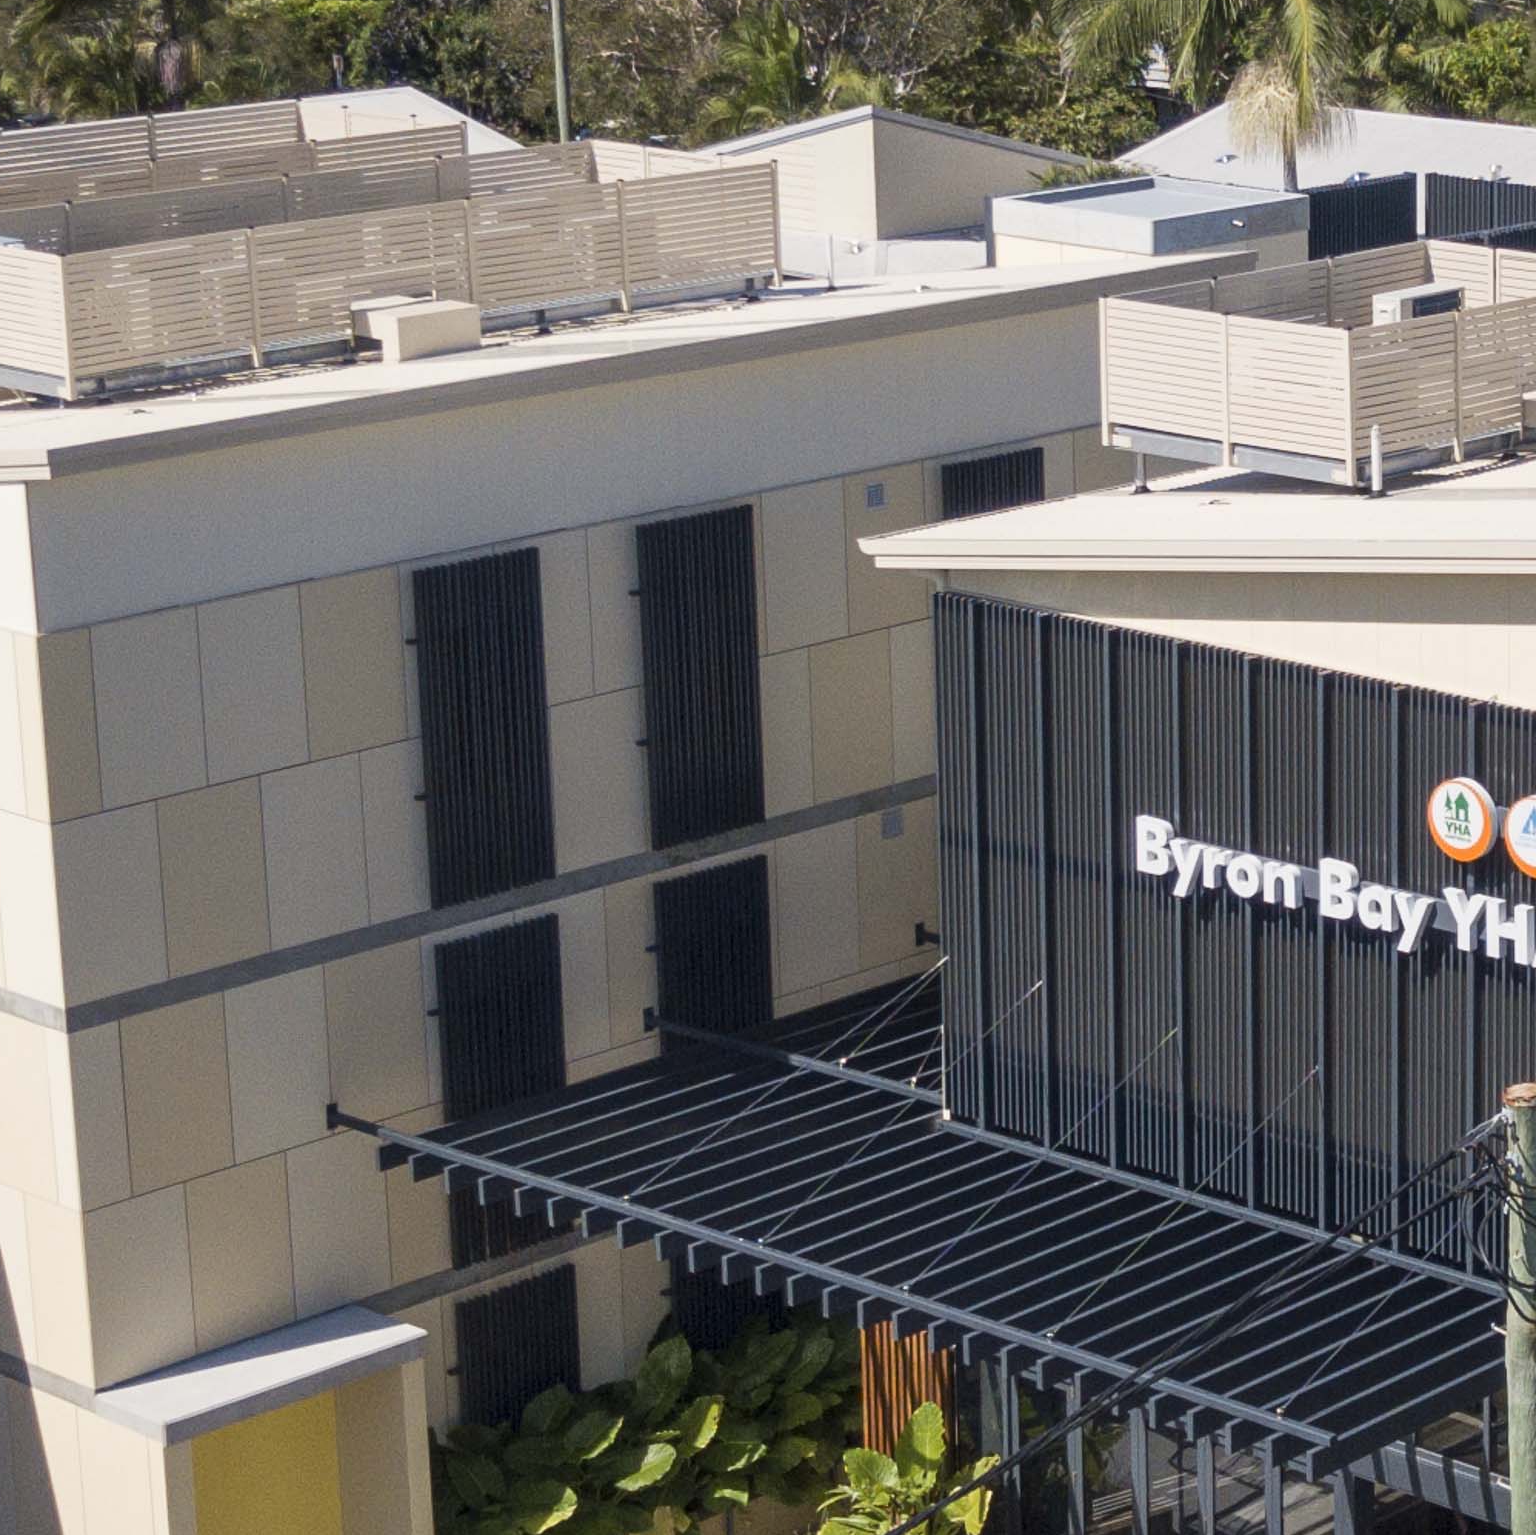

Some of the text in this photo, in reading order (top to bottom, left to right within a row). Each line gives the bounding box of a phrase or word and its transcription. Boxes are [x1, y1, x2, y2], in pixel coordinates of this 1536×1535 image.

[1445, 821, 1472, 837] YHA
[1136, 815, 1301, 909] Byron
[1319, 857, 1434, 953] Bay
